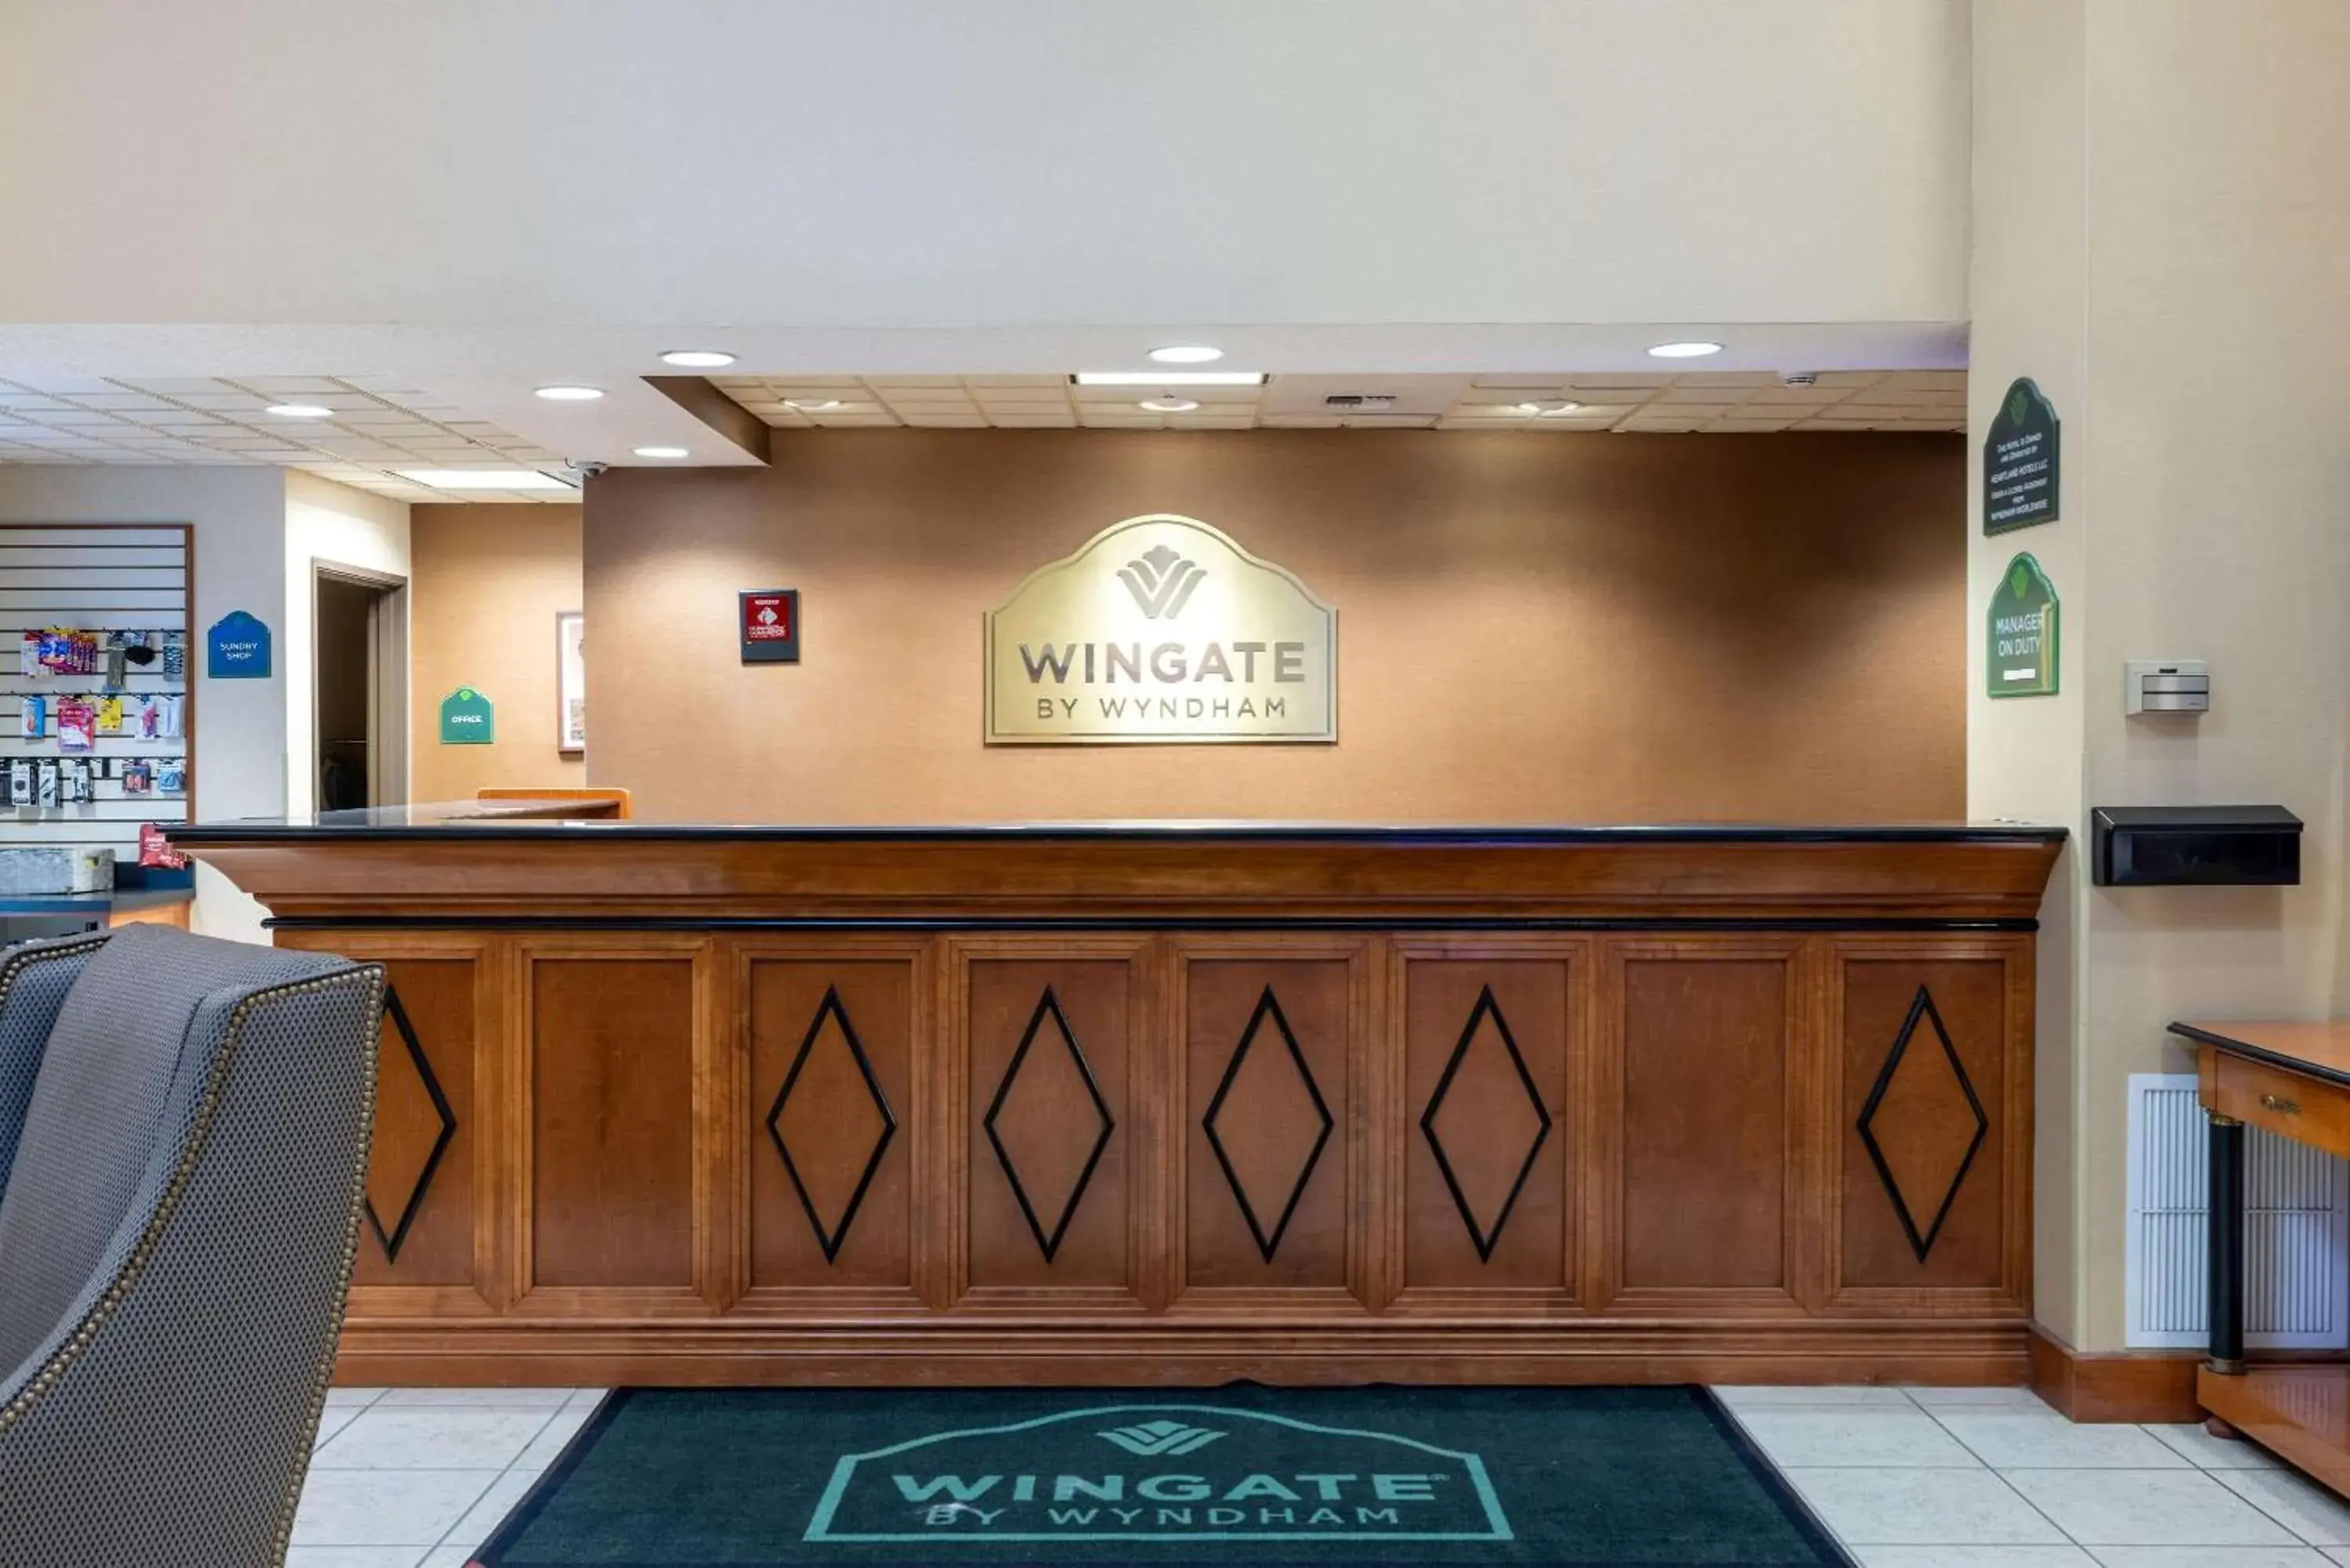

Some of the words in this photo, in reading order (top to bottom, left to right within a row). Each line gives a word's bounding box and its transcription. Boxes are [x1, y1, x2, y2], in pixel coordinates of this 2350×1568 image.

[219, 642, 258, 651] SUNDRY
[226, 652, 251, 660] SHOP
[1998, 639, 2014, 656] ON
[2015, 637, 2041, 656] DUTY
[1018, 641, 1307, 685] WINGATE
[1037, 698, 1079, 719] BY
[1098, 697, 1286, 719] WYNDHAM
[924, 1504, 1007, 1525] BY
[1047, 1508, 1399, 1525] WYNDHAM
